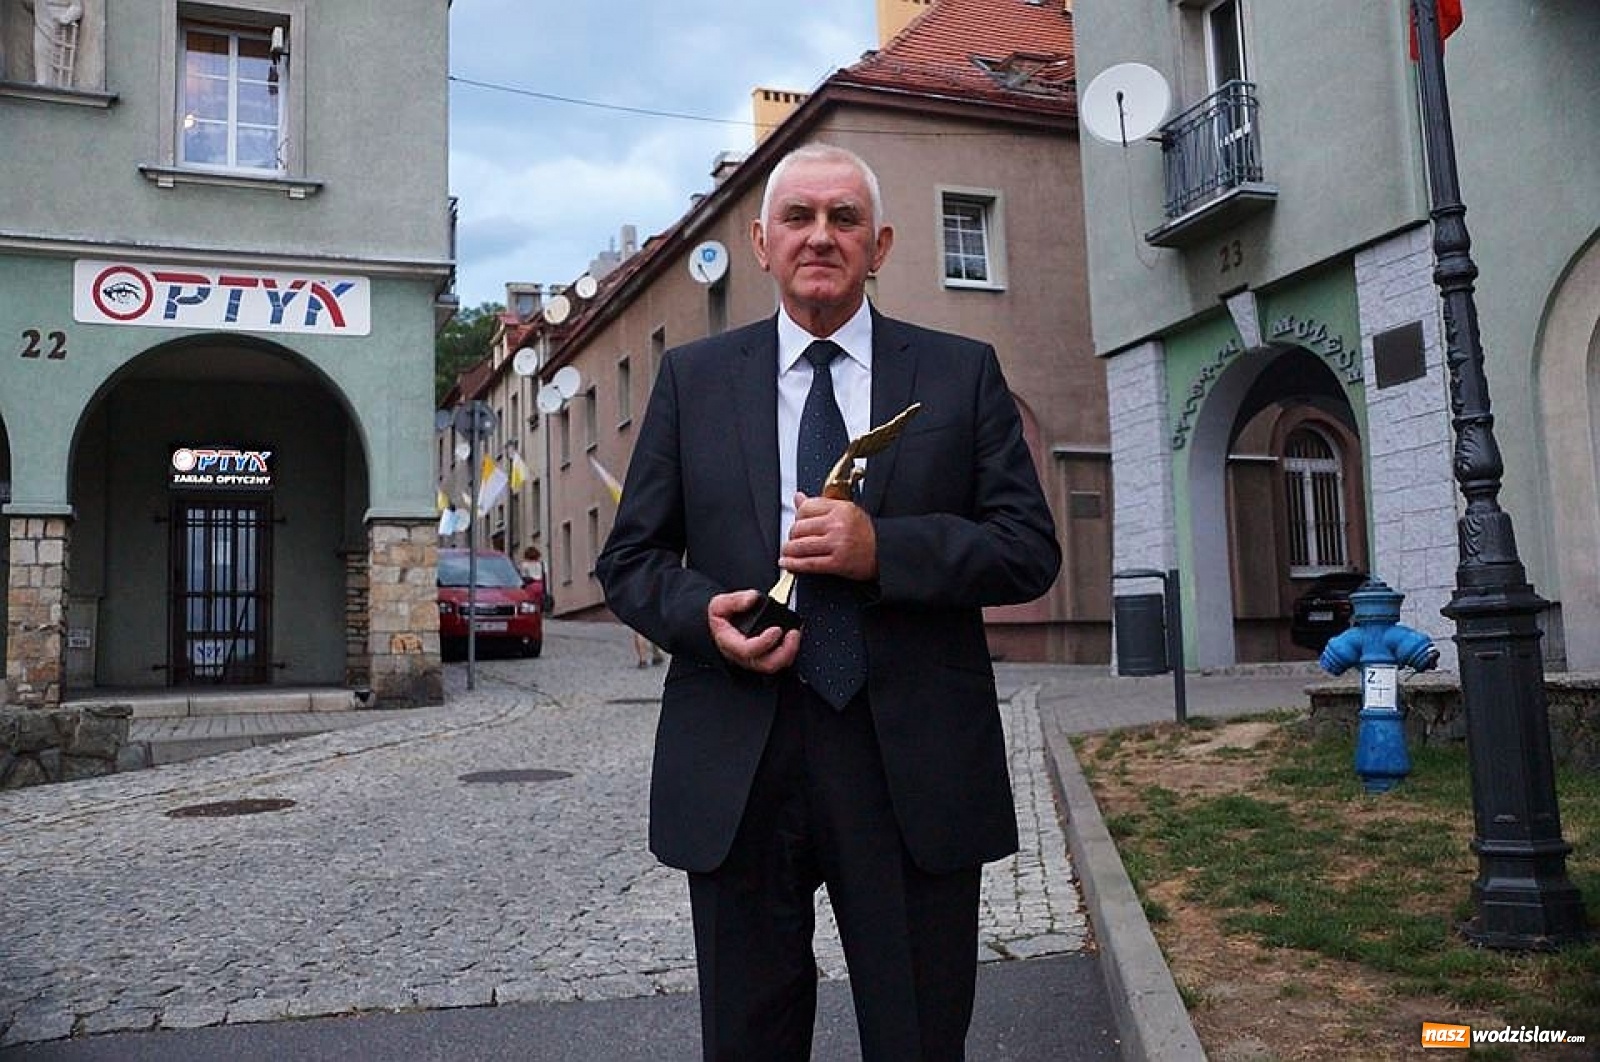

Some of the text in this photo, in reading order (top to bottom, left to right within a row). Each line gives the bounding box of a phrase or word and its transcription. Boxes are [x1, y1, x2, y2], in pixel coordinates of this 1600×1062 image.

[1219, 239, 1243, 273] 23
[92, 266, 355, 328] OPTYK
[20, 329, 68, 361] 22
[172, 448, 272, 472] OPTYK
[173, 474, 271, 485] ZAKŁAD OPTYCZNY
